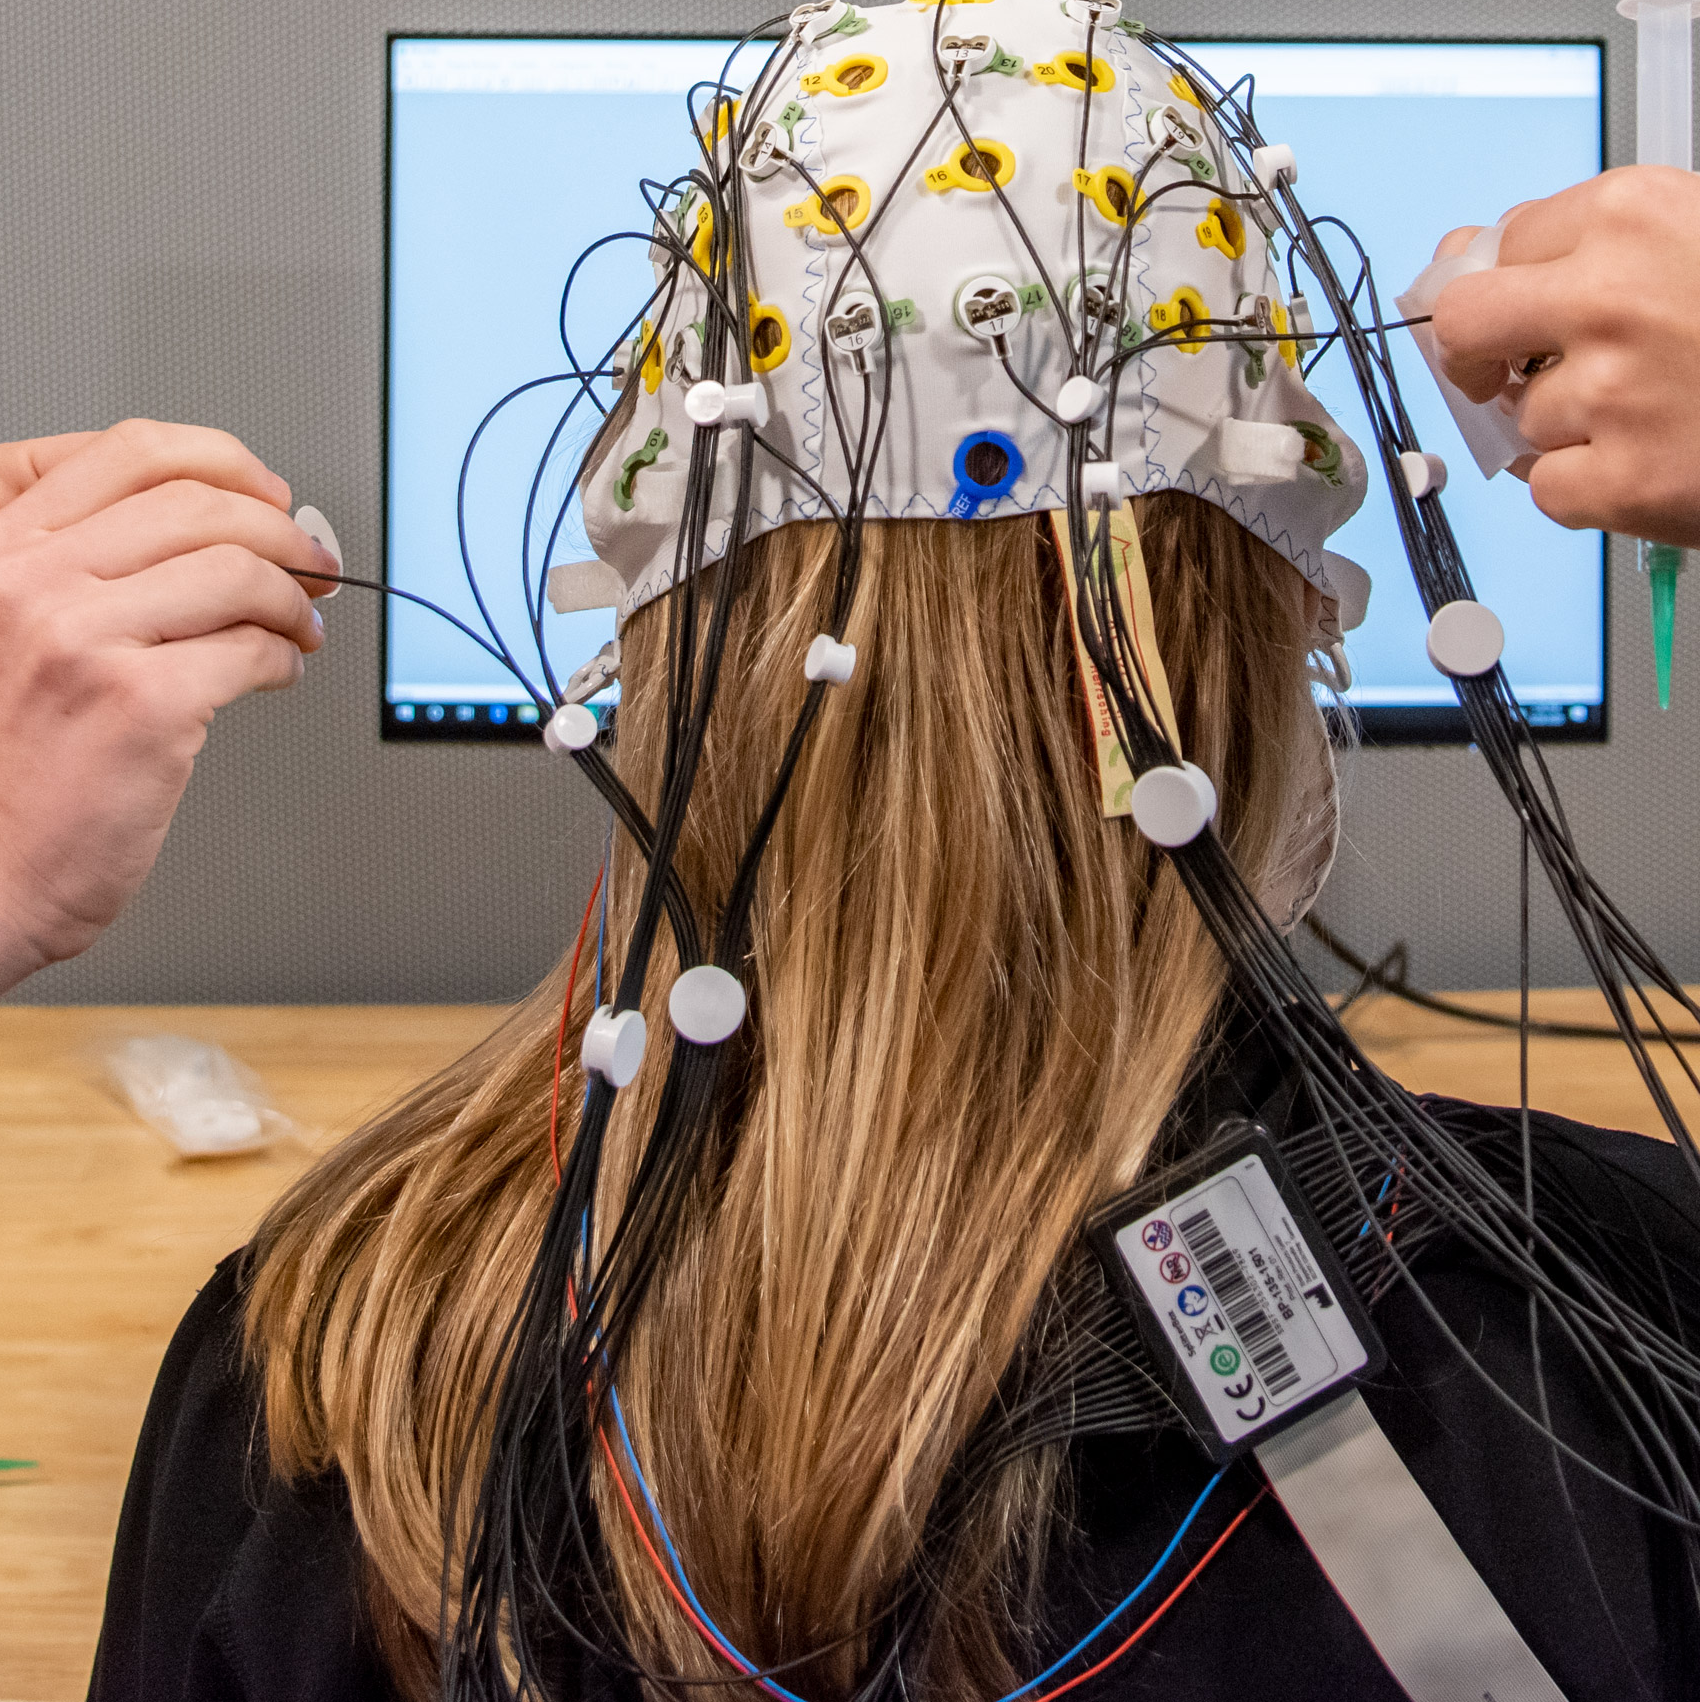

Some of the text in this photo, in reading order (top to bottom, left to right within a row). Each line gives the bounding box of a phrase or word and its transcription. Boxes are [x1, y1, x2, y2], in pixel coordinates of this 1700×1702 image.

[955, 50, 968, 58] 13
[1001, 59, 1017, 67] 13
[1038, 66, 1055, 75] 20
[803, 76, 821, 85] 12
[783, 105, 796, 121] 14
[1172, 126, 1185, 139] 19
[761, 141, 773, 155] 14
[1196, 160, 1212, 175] 19
[928, 170, 948, 183] 16
[1077, 174, 1091, 186] 17
[699, 207, 709, 224] 13
[786, 208, 804, 219] 15
[1203, 226, 1213, 239] 19
[1026, 291, 1044, 305] 17
[1155, 308, 1167, 321] 18
[990, 318, 1005, 332] 17
[848, 335, 864, 347] 16
[650, 430, 661, 447] 10
[1326, 472, 1343, 487] 21
[952, 493, 971, 518] REF
[1247, 1246, 1294, 1320] BP-135-1501
[1165, 1308, 1197, 1357] SplitterBox
